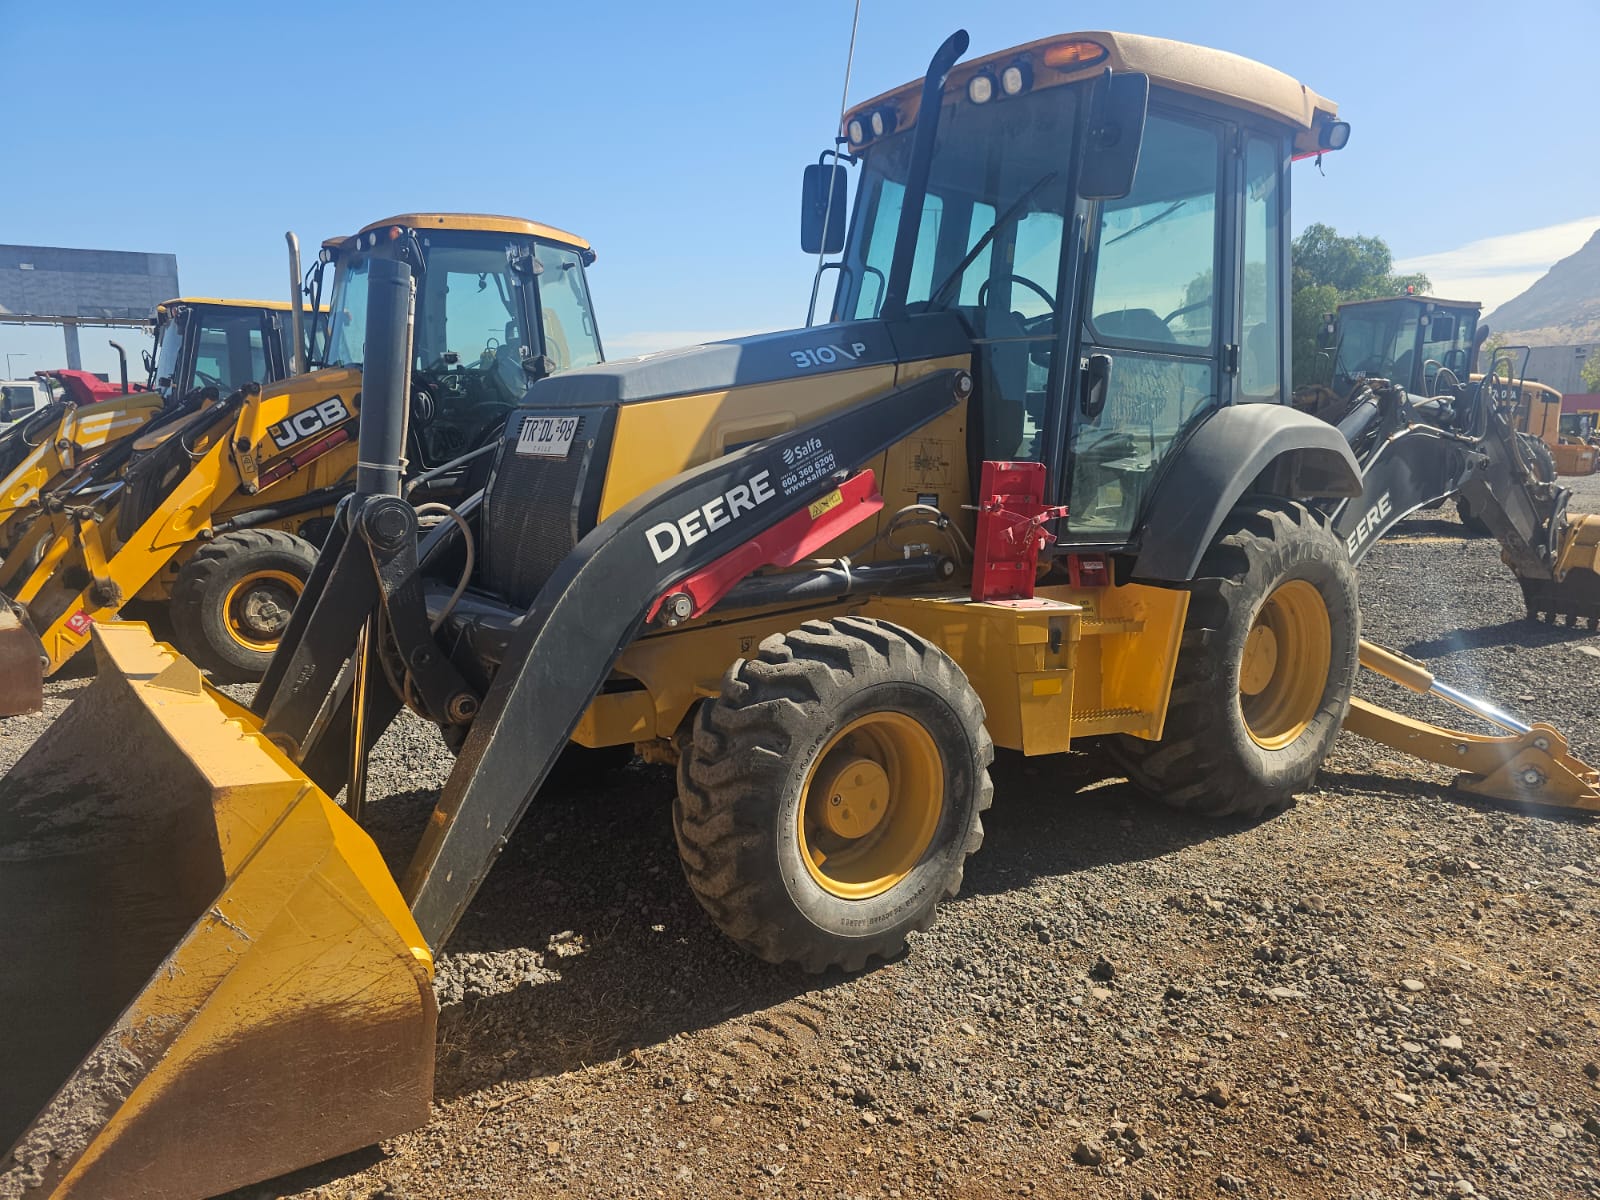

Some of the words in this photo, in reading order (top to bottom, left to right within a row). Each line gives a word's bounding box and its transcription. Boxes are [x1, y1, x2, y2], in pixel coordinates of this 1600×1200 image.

[275, 398, 347, 447] JCB
[794, 437, 822, 460] Salfa
[782, 474, 798, 488] 600
[798, 465, 814, 479] 360
[814, 453, 835, 469] 6200
[784, 461, 836, 496] www.salfa.cl
[645, 469, 776, 564] DEERE
[1346, 491, 1392, 559] EERE
